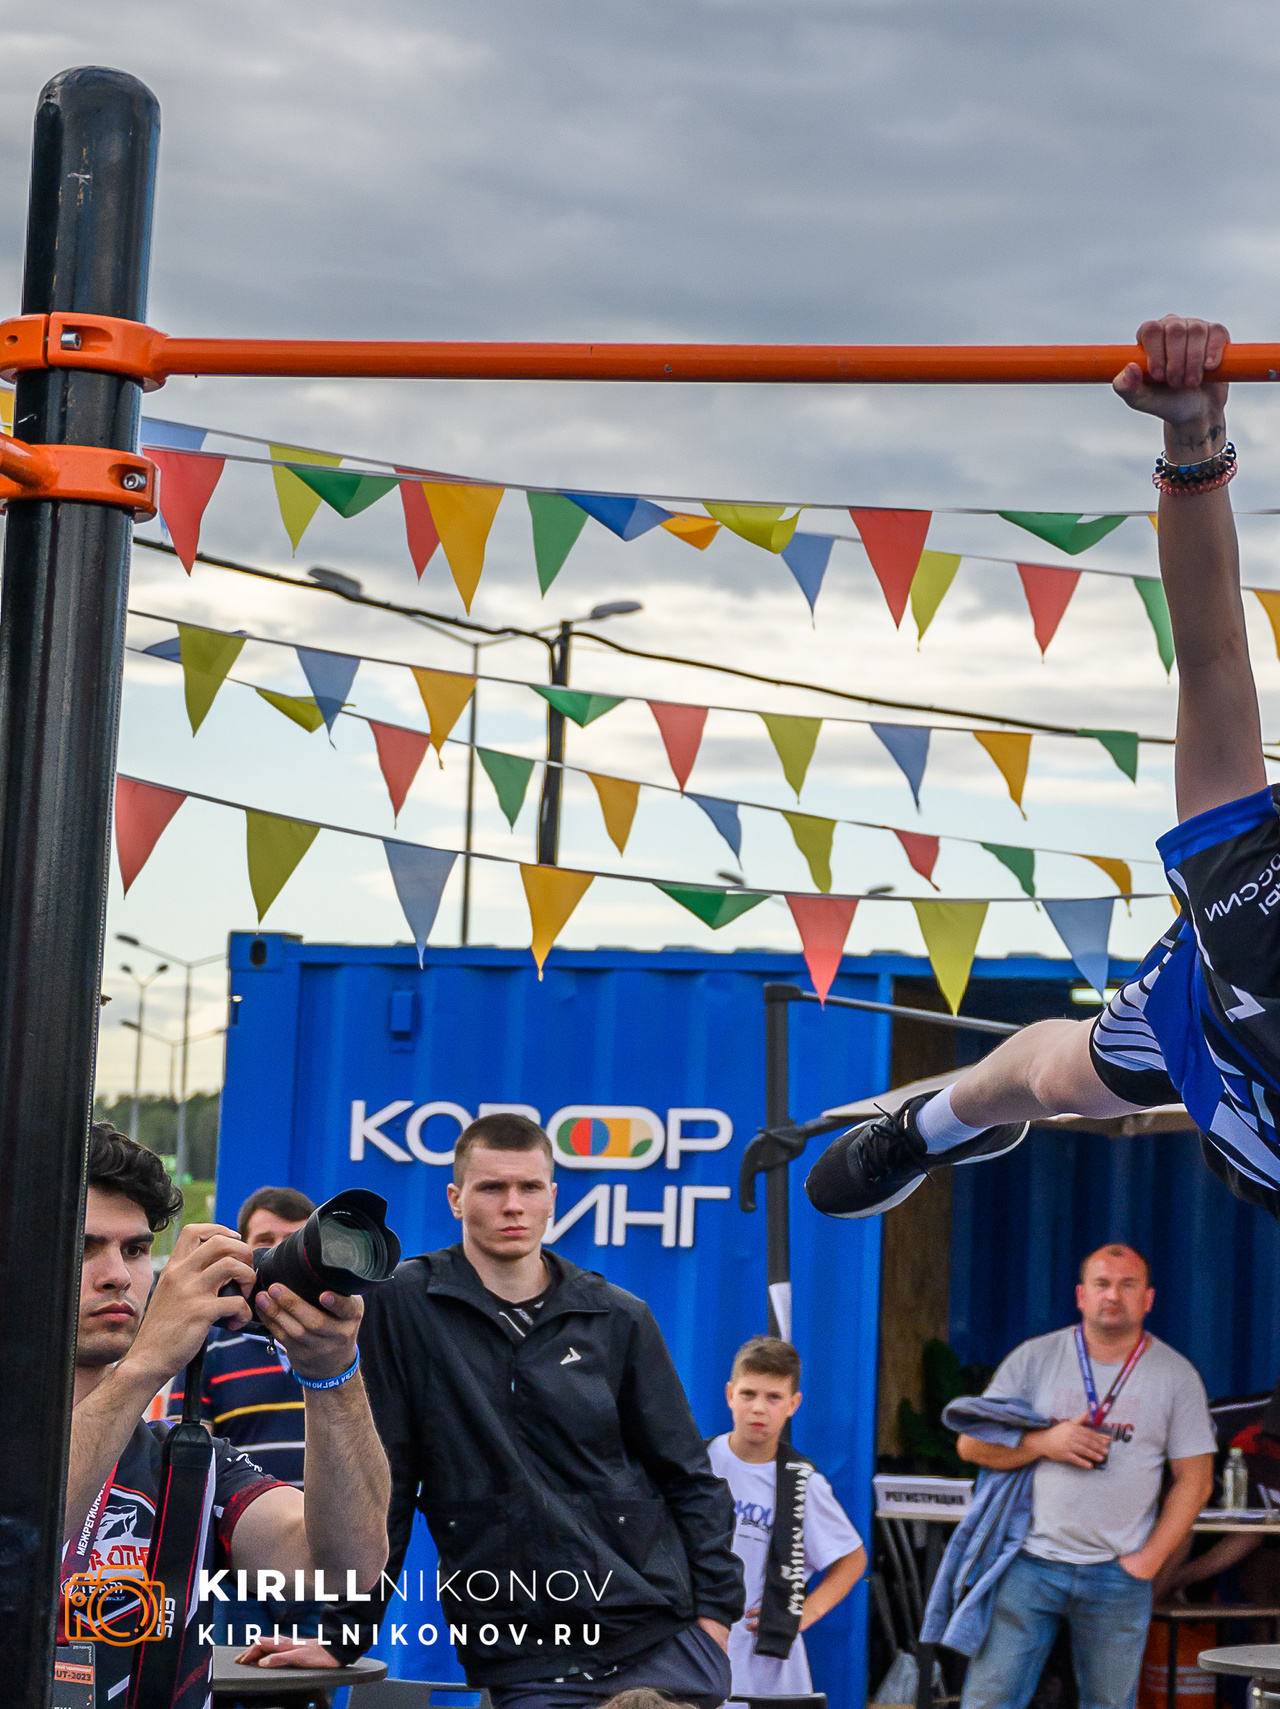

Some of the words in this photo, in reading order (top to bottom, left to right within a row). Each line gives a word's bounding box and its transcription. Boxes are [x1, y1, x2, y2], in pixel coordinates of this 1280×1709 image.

[349, 1099, 734, 1171] КООР
[542, 1183, 732, 1249] ИНГ
[56, 1670, 92, 1682] UT-2023
